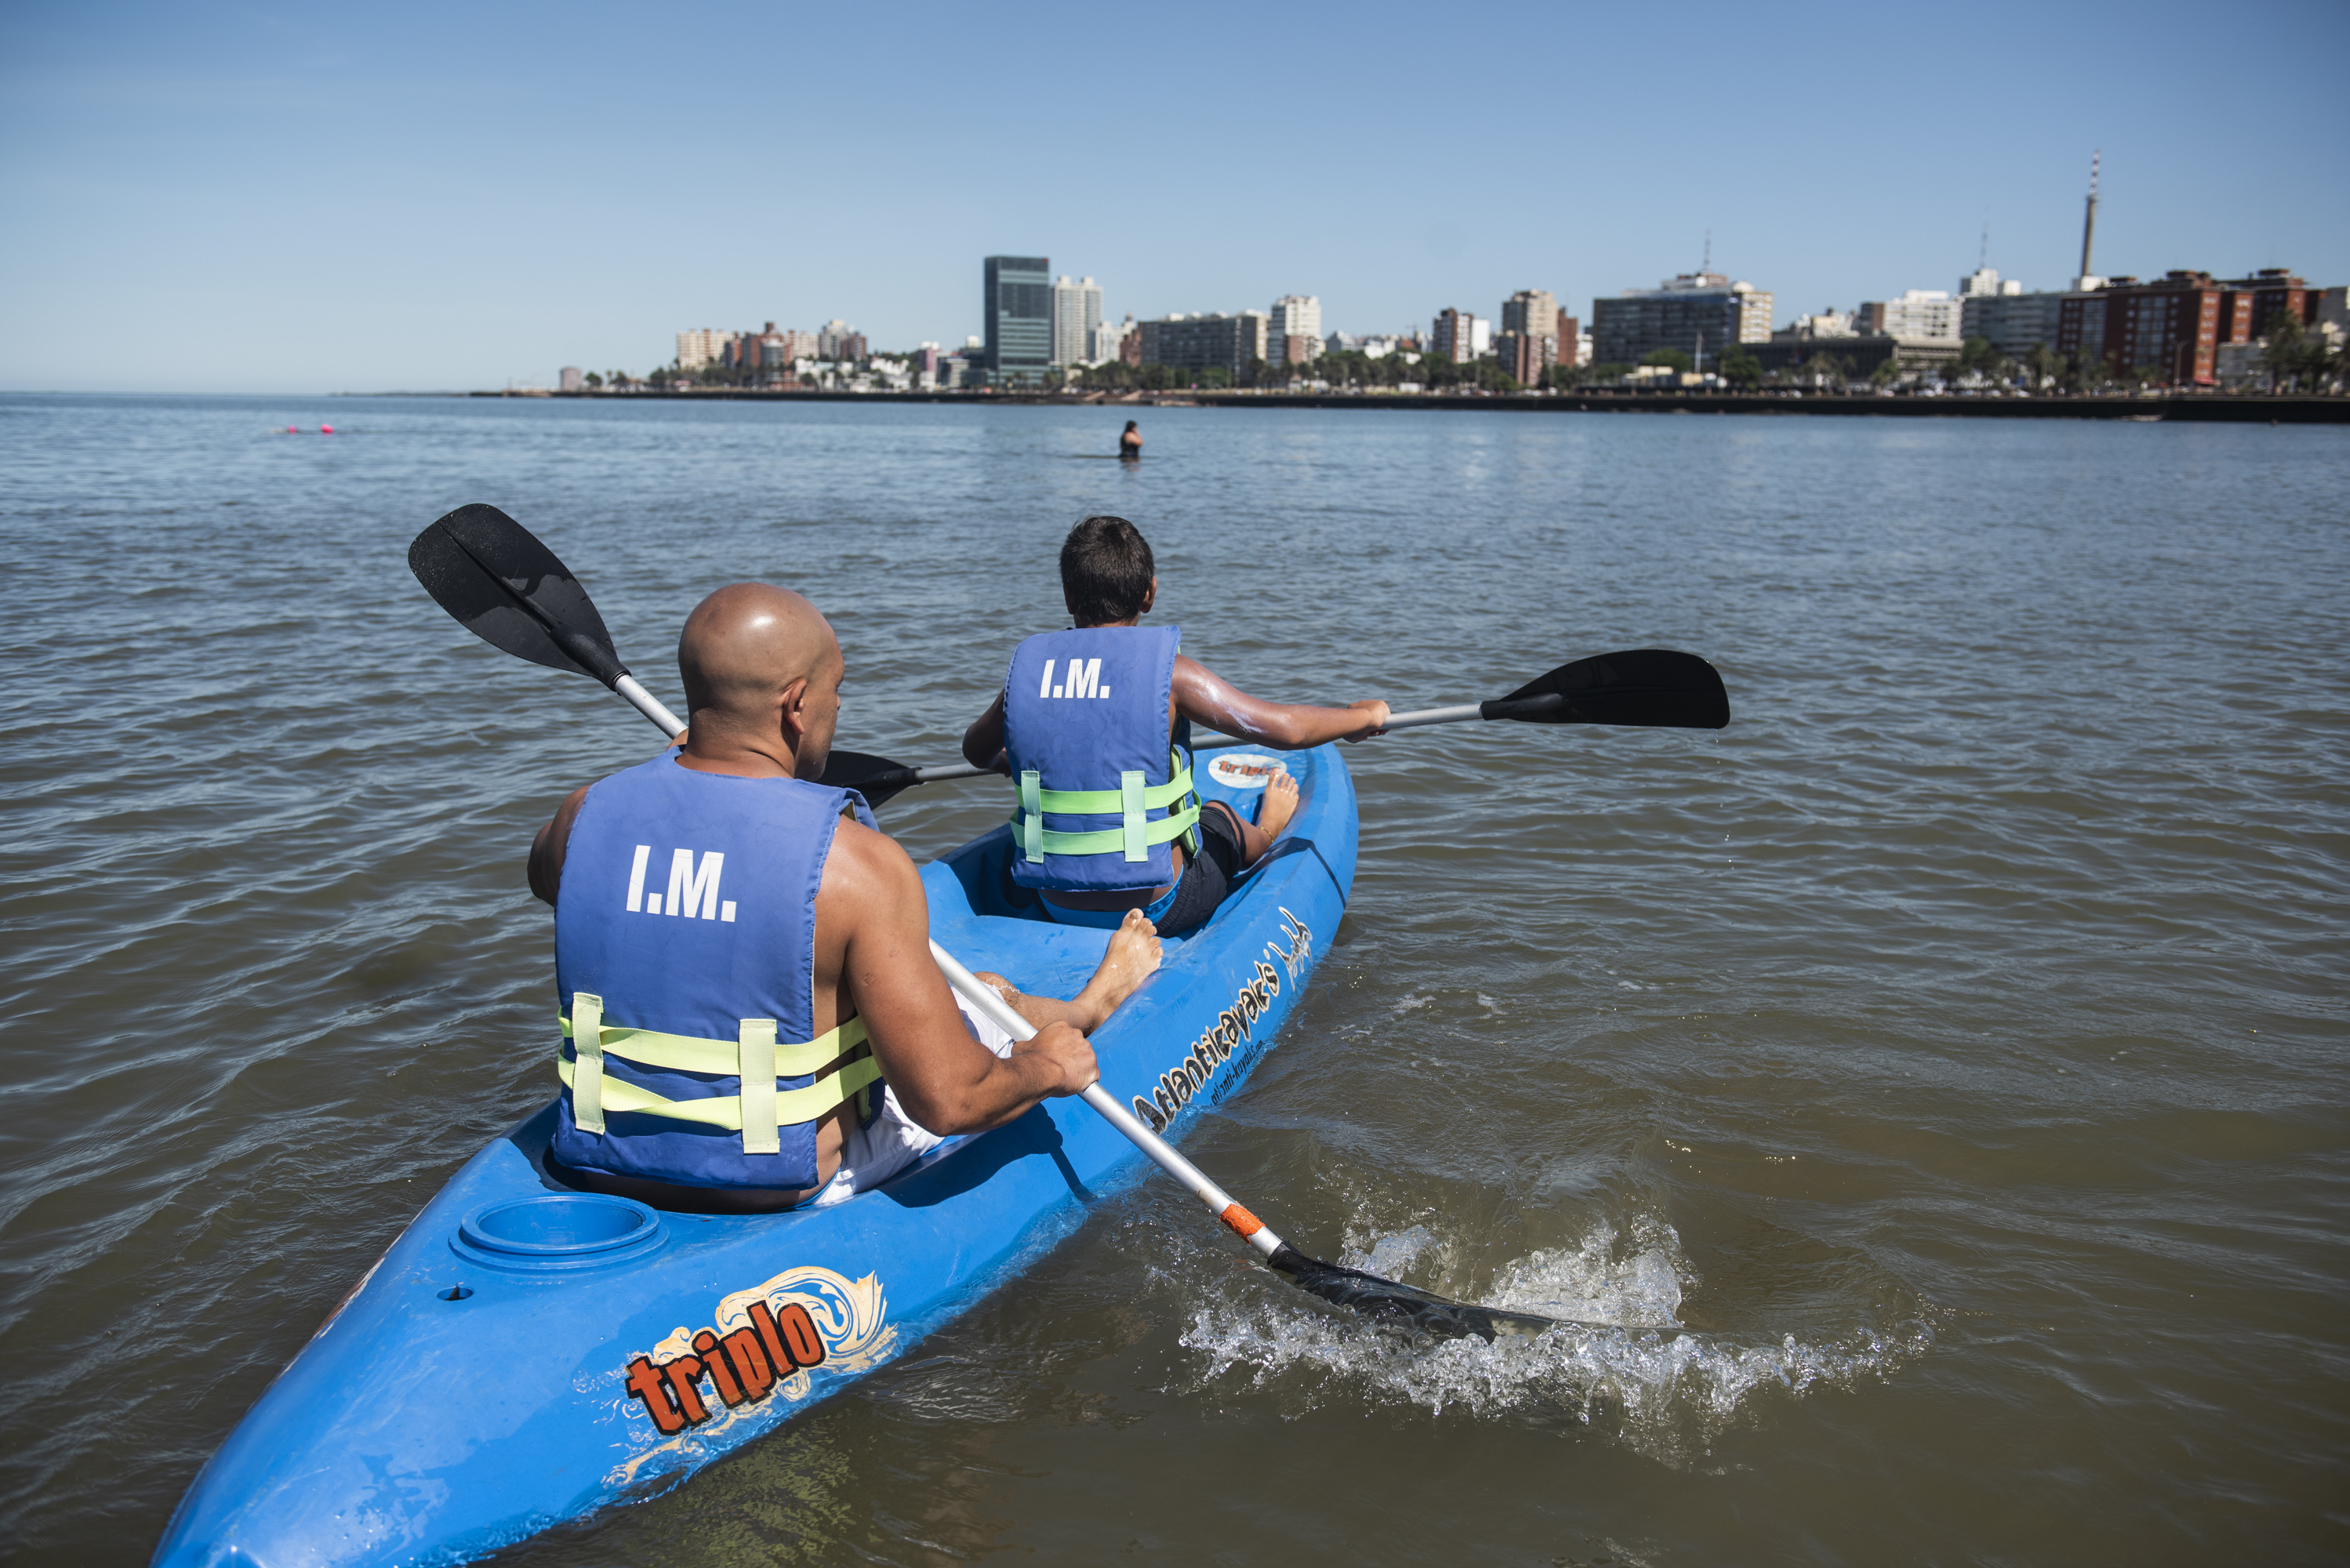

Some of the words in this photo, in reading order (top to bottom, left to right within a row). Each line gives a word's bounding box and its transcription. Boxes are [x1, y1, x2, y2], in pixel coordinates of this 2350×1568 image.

[1040, 659, 1110, 699] I.M.
[627, 844, 737, 923] I.M.
[625, 1300, 826, 1436] triplo
